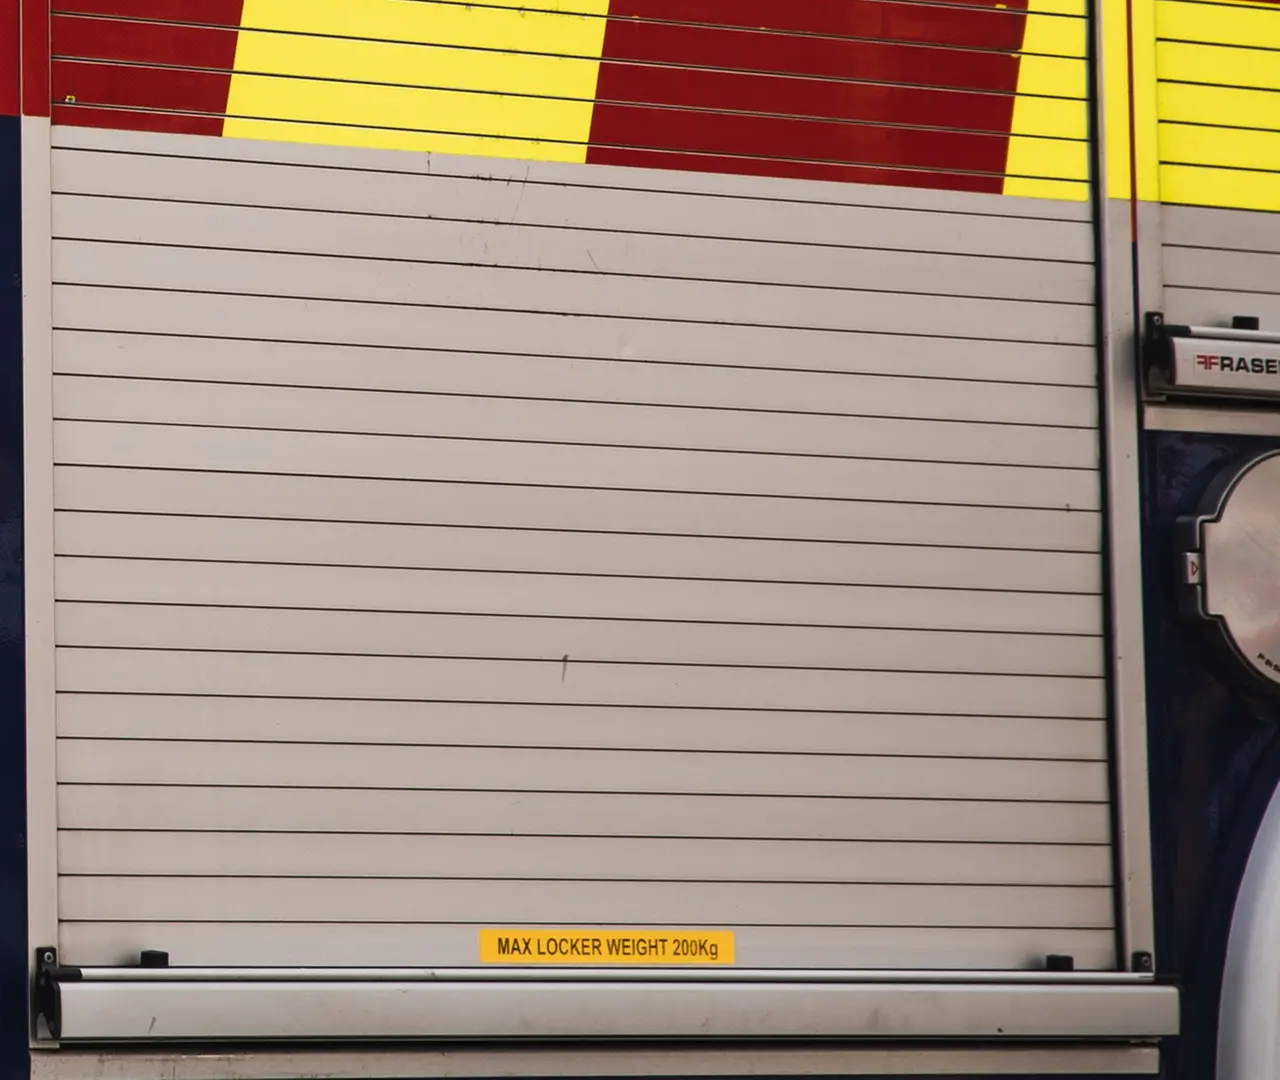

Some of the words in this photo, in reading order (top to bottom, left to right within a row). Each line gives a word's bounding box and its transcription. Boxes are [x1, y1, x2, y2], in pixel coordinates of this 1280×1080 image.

[1196, 354, 1280, 374] FRASE
[497, 937, 532, 955] MAX
[537, 938, 602, 955] LOCKER
[606, 938, 668, 956] WEIGHT
[672, 939, 719, 960] 200Kg
